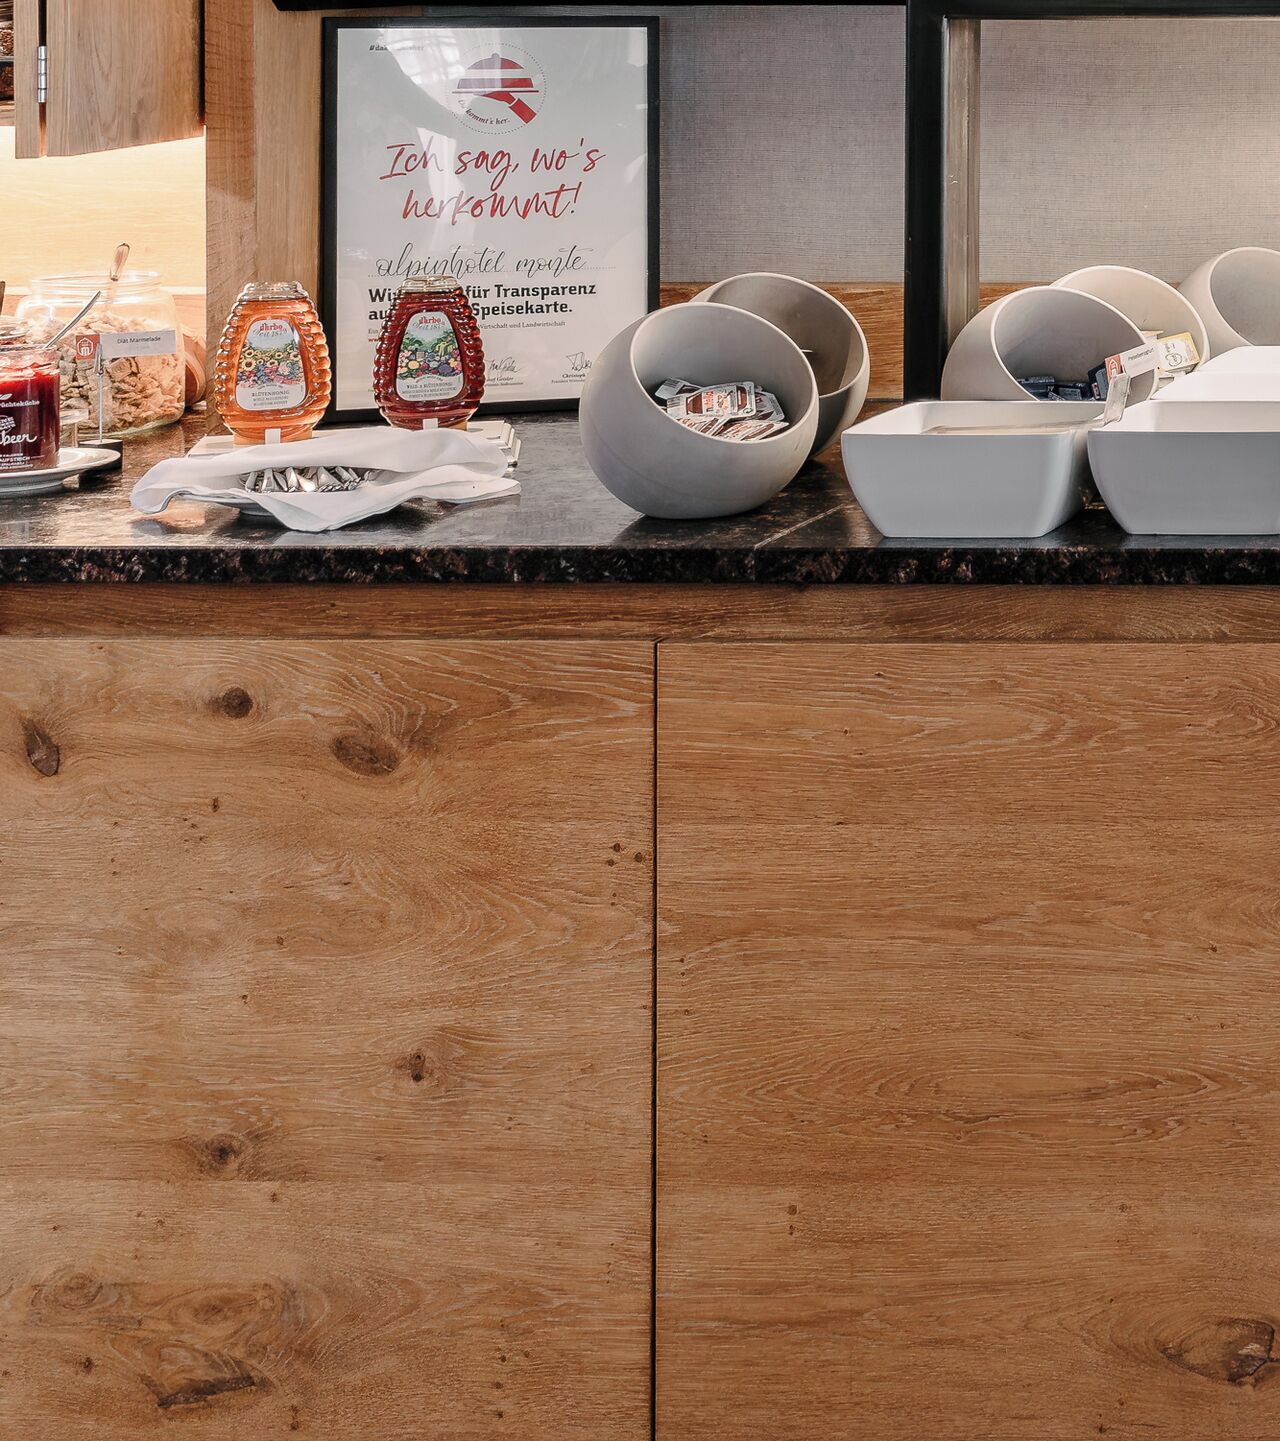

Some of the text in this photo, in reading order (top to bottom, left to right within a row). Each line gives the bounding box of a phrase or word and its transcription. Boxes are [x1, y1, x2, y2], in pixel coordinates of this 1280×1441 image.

[379, 136, 606, 191] Ich sag, wo's
[402, 182, 582, 225] herkommt!
[376, 242, 594, 279] alpinhotel monte
[465, 285, 490, 298] für
[494, 283, 596, 299] Transparenz
[368, 300, 573, 320] au Speisekarte.
[0, 430, 38, 446] beer
